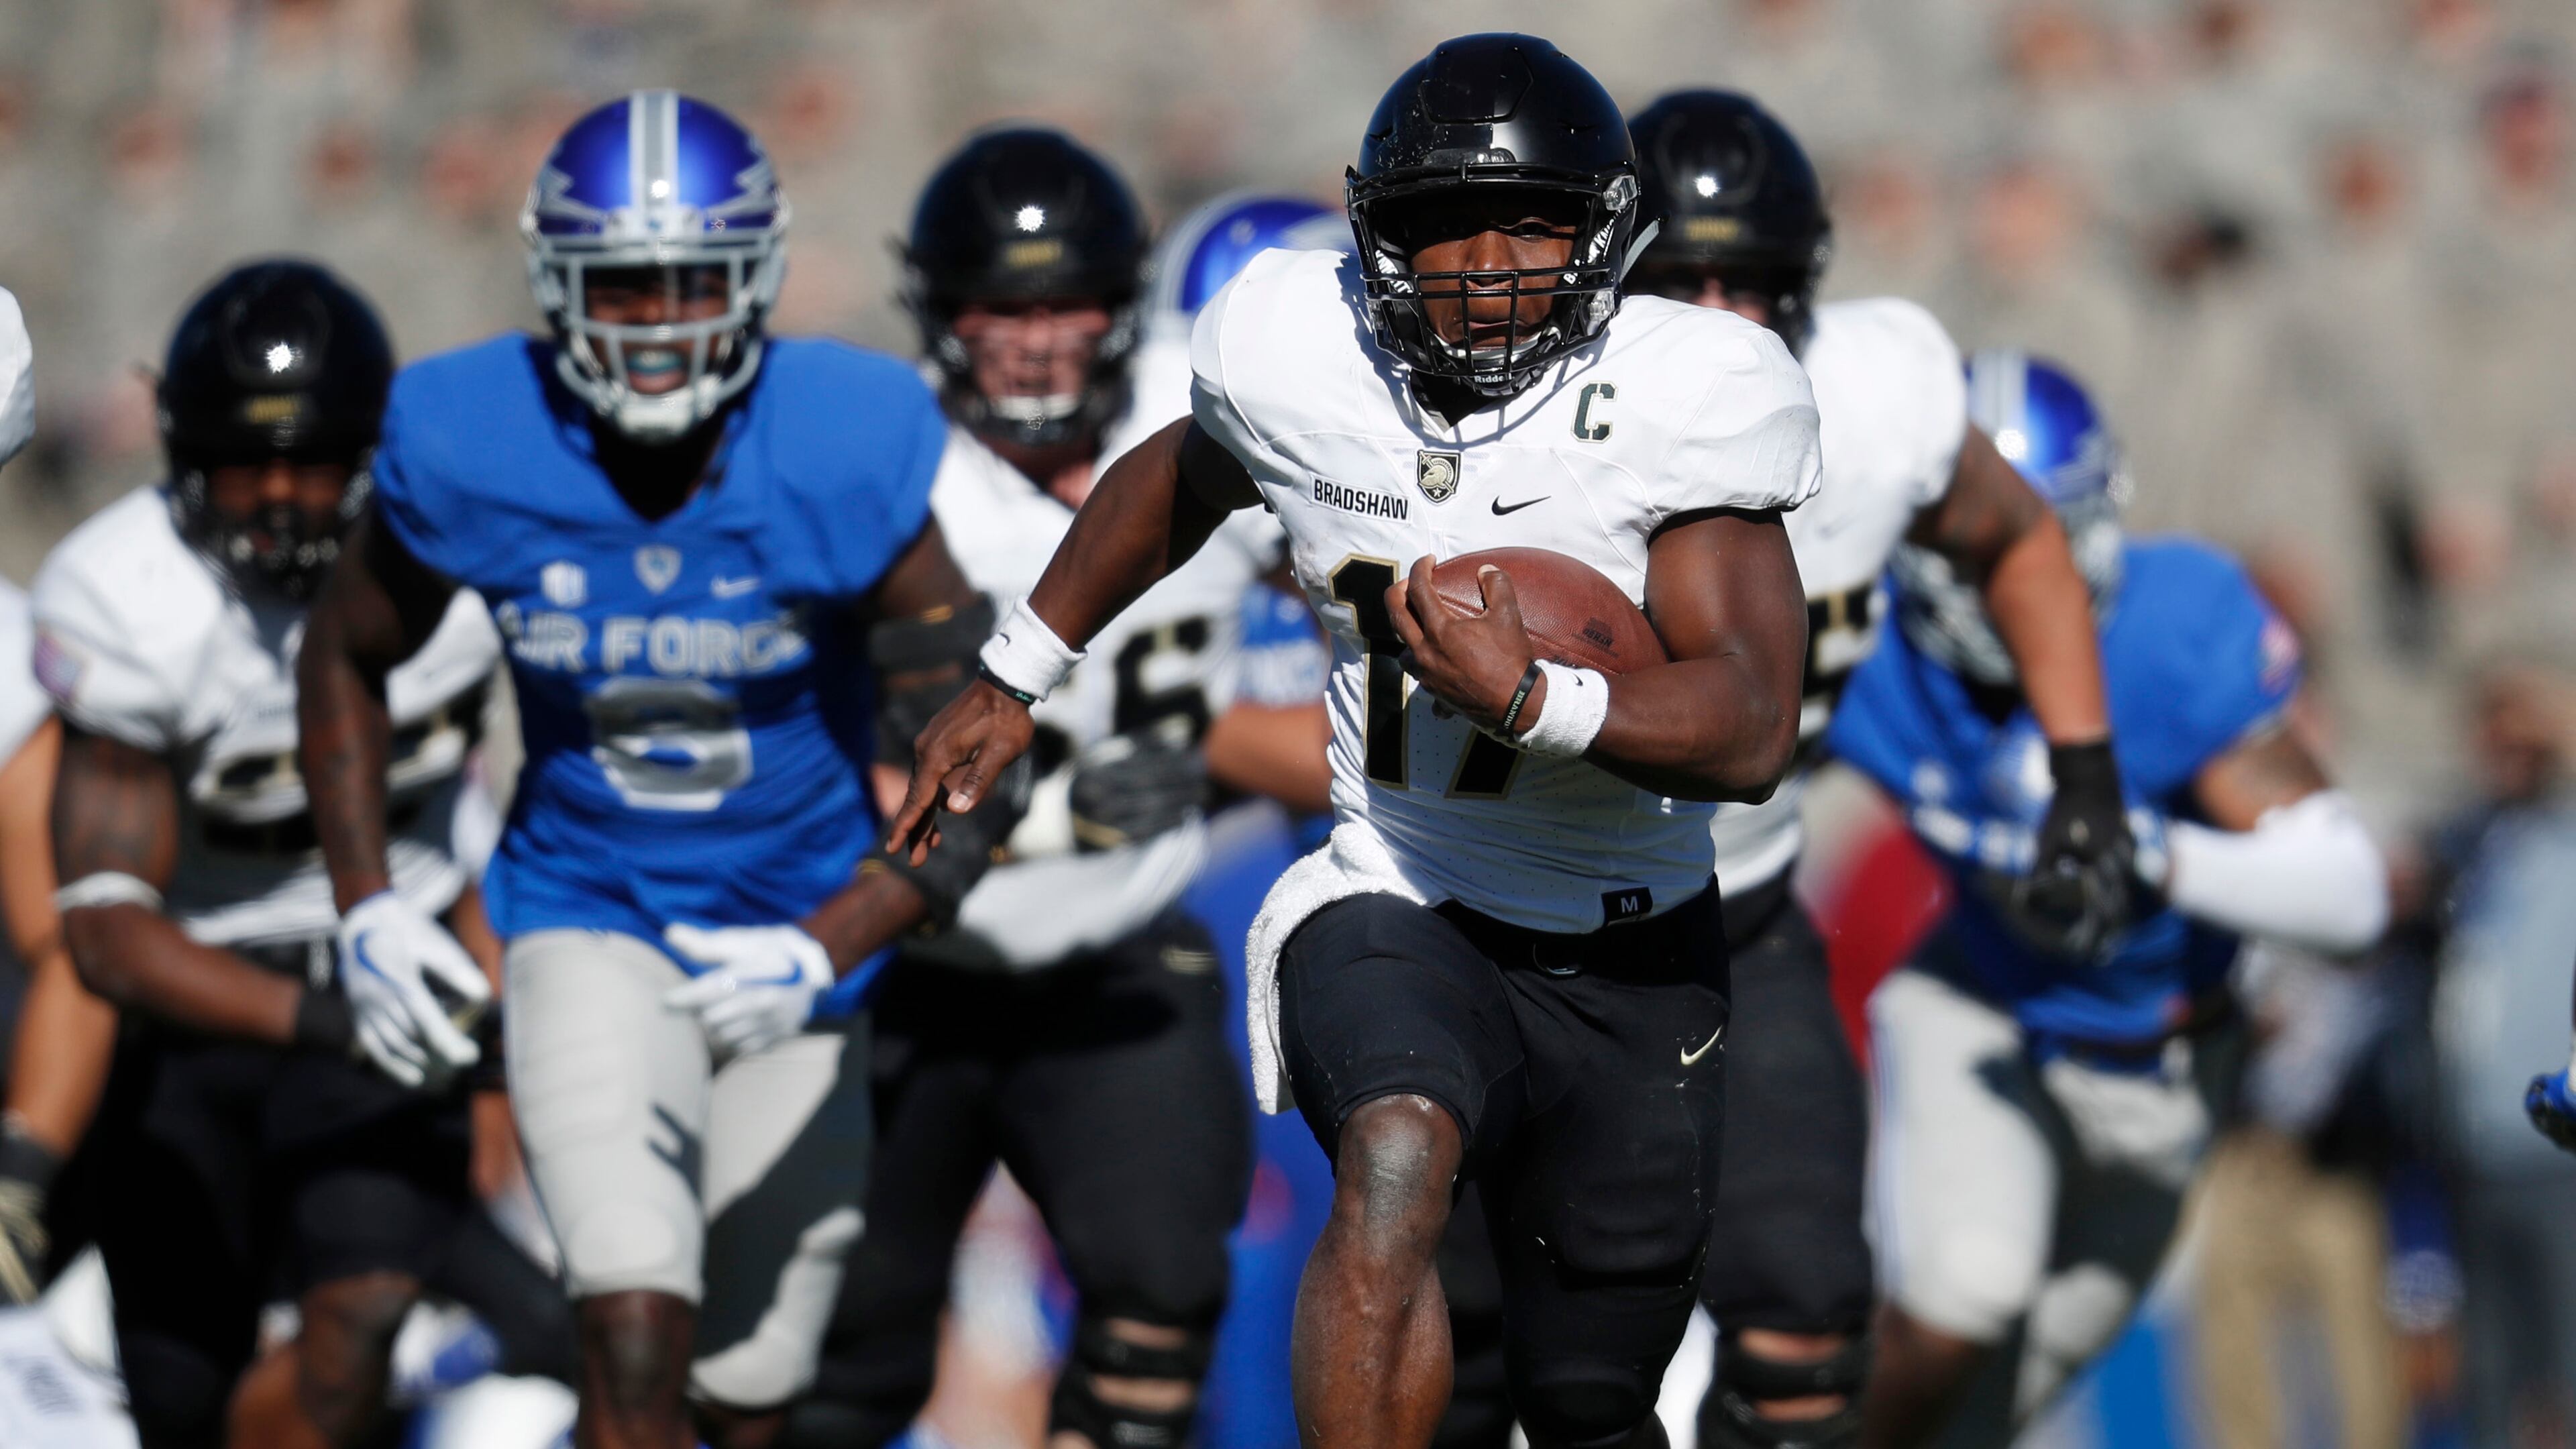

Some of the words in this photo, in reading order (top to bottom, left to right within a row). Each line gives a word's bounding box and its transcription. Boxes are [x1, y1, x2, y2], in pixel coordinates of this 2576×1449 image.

[1570, 381, 1619, 444] C
[1314, 478, 1409, 521] BRADSHAW
[1503, 689, 1526, 730] BRANDO
[1620, 895, 1639, 914] M
